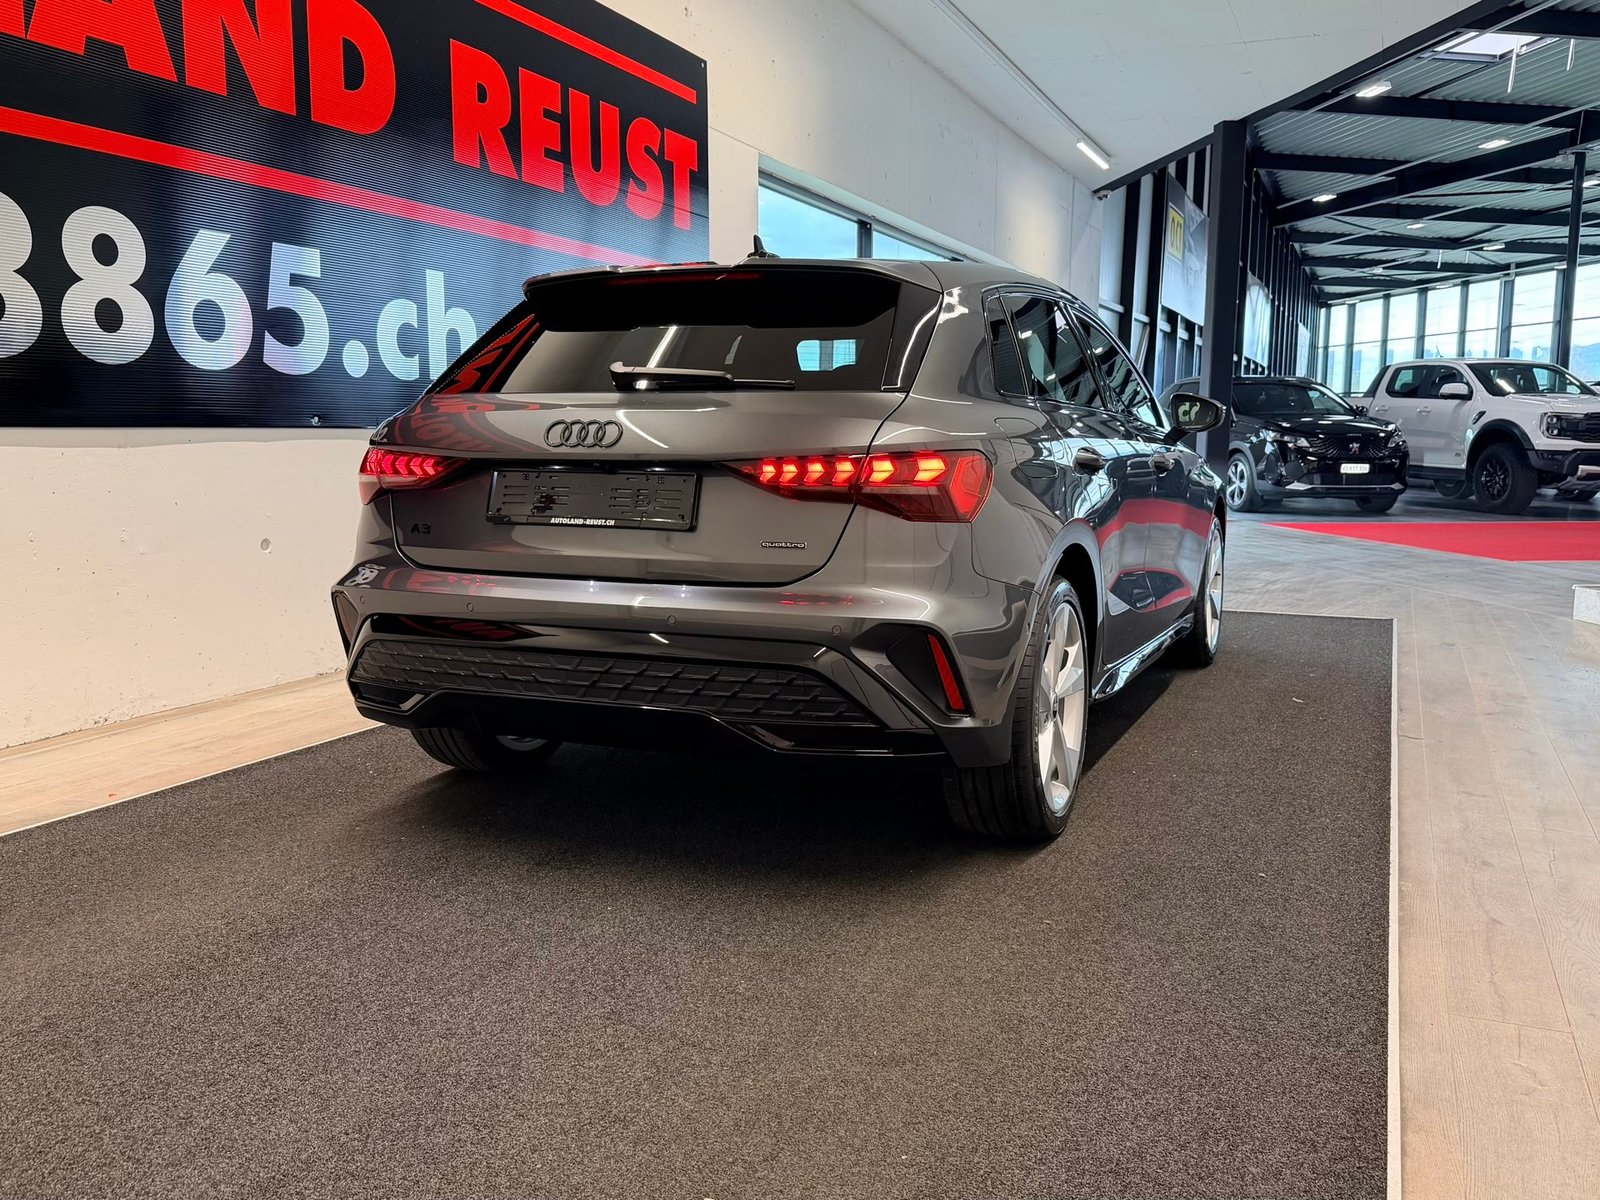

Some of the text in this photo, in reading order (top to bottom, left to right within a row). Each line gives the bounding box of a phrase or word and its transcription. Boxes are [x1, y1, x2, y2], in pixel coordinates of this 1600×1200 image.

[0, 0, 698, 232] AND REUST
[550, 517, 616, 526] AUTOLAND-REUST.CH
[410, 522, 432, 535] A3
[761, 541, 806, 549] quattro
